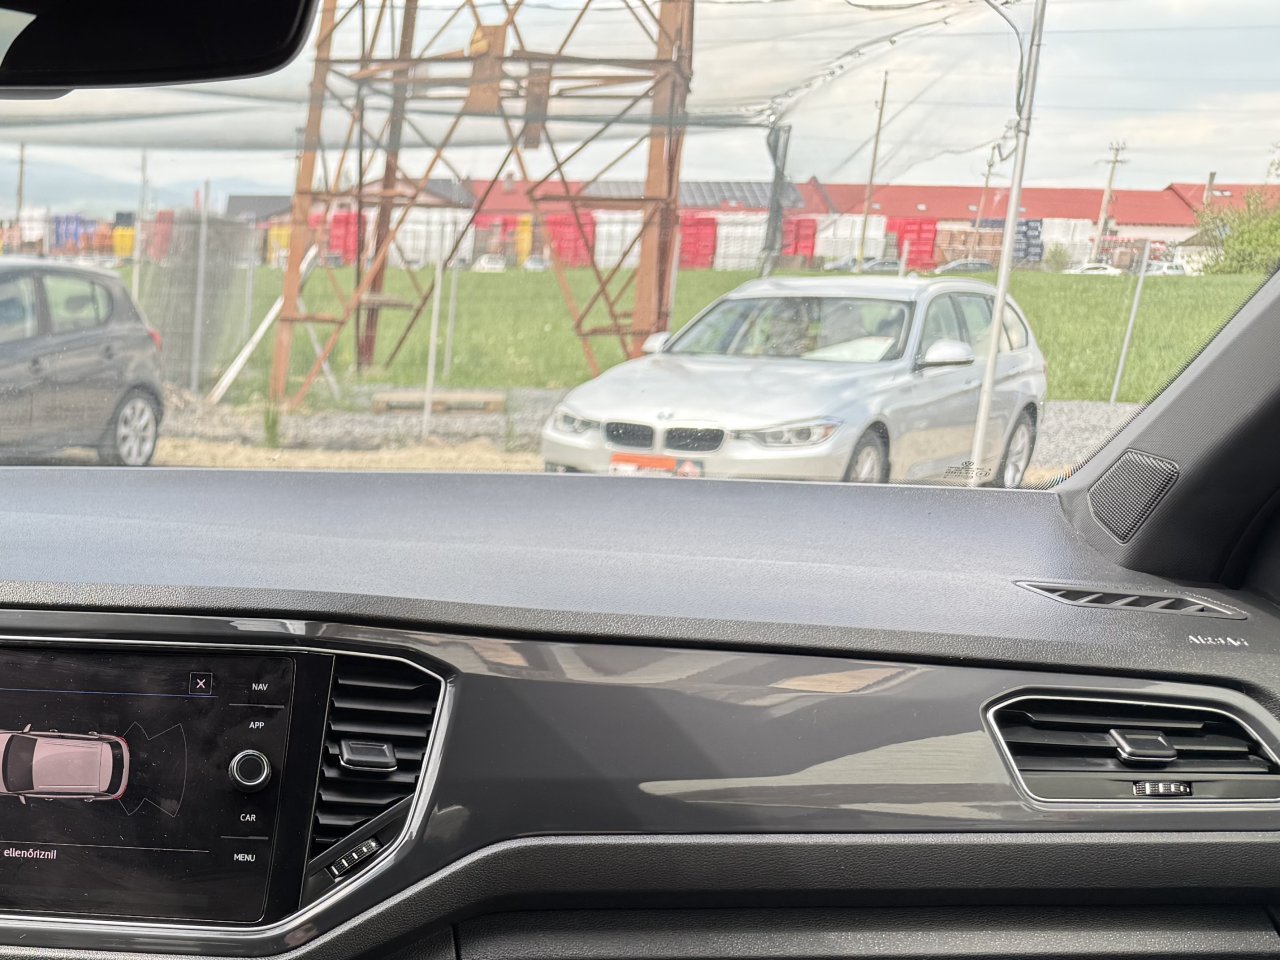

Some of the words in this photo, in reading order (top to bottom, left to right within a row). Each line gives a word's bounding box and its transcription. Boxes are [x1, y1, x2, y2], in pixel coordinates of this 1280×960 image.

[252, 682, 269, 691] NAV
[248, 721, 265, 729] APP
[240, 813, 256, 822] CAR
[233, 853, 256, 862] MENU
